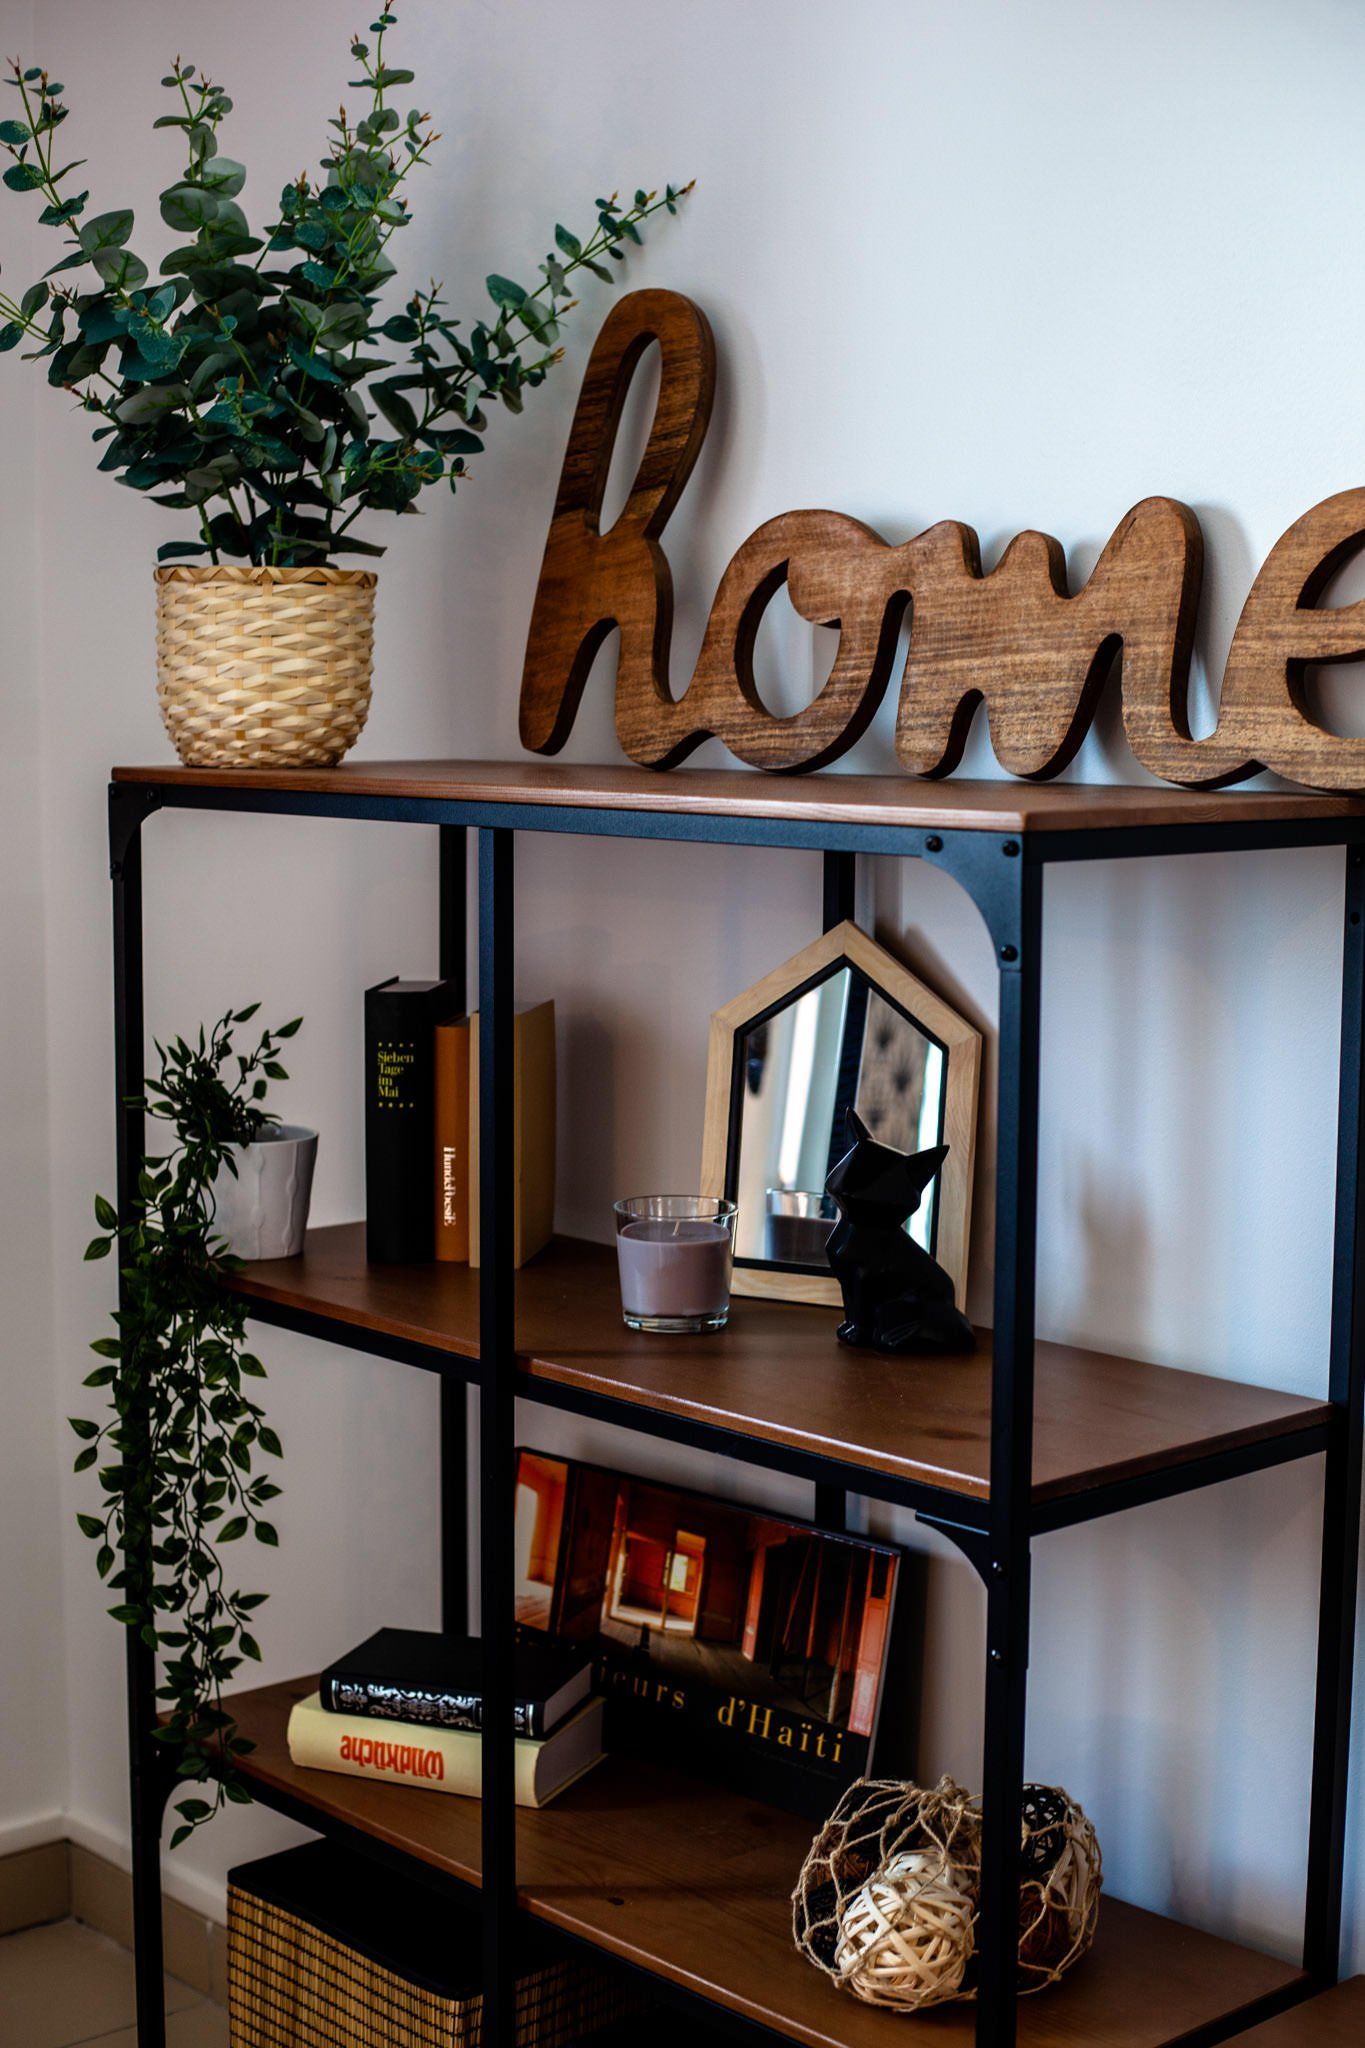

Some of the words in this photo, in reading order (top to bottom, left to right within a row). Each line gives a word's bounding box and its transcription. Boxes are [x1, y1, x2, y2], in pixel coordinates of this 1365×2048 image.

[519, 288, 1365, 794] home
[377, 1051, 415, 1063] Sieben
[379, 1063, 405, 1076] Tage
[378, 1075, 393, 1086] im
[378, 1086, 399, 1098] Mai
[340, 1735, 444, 1781] Wildküche
